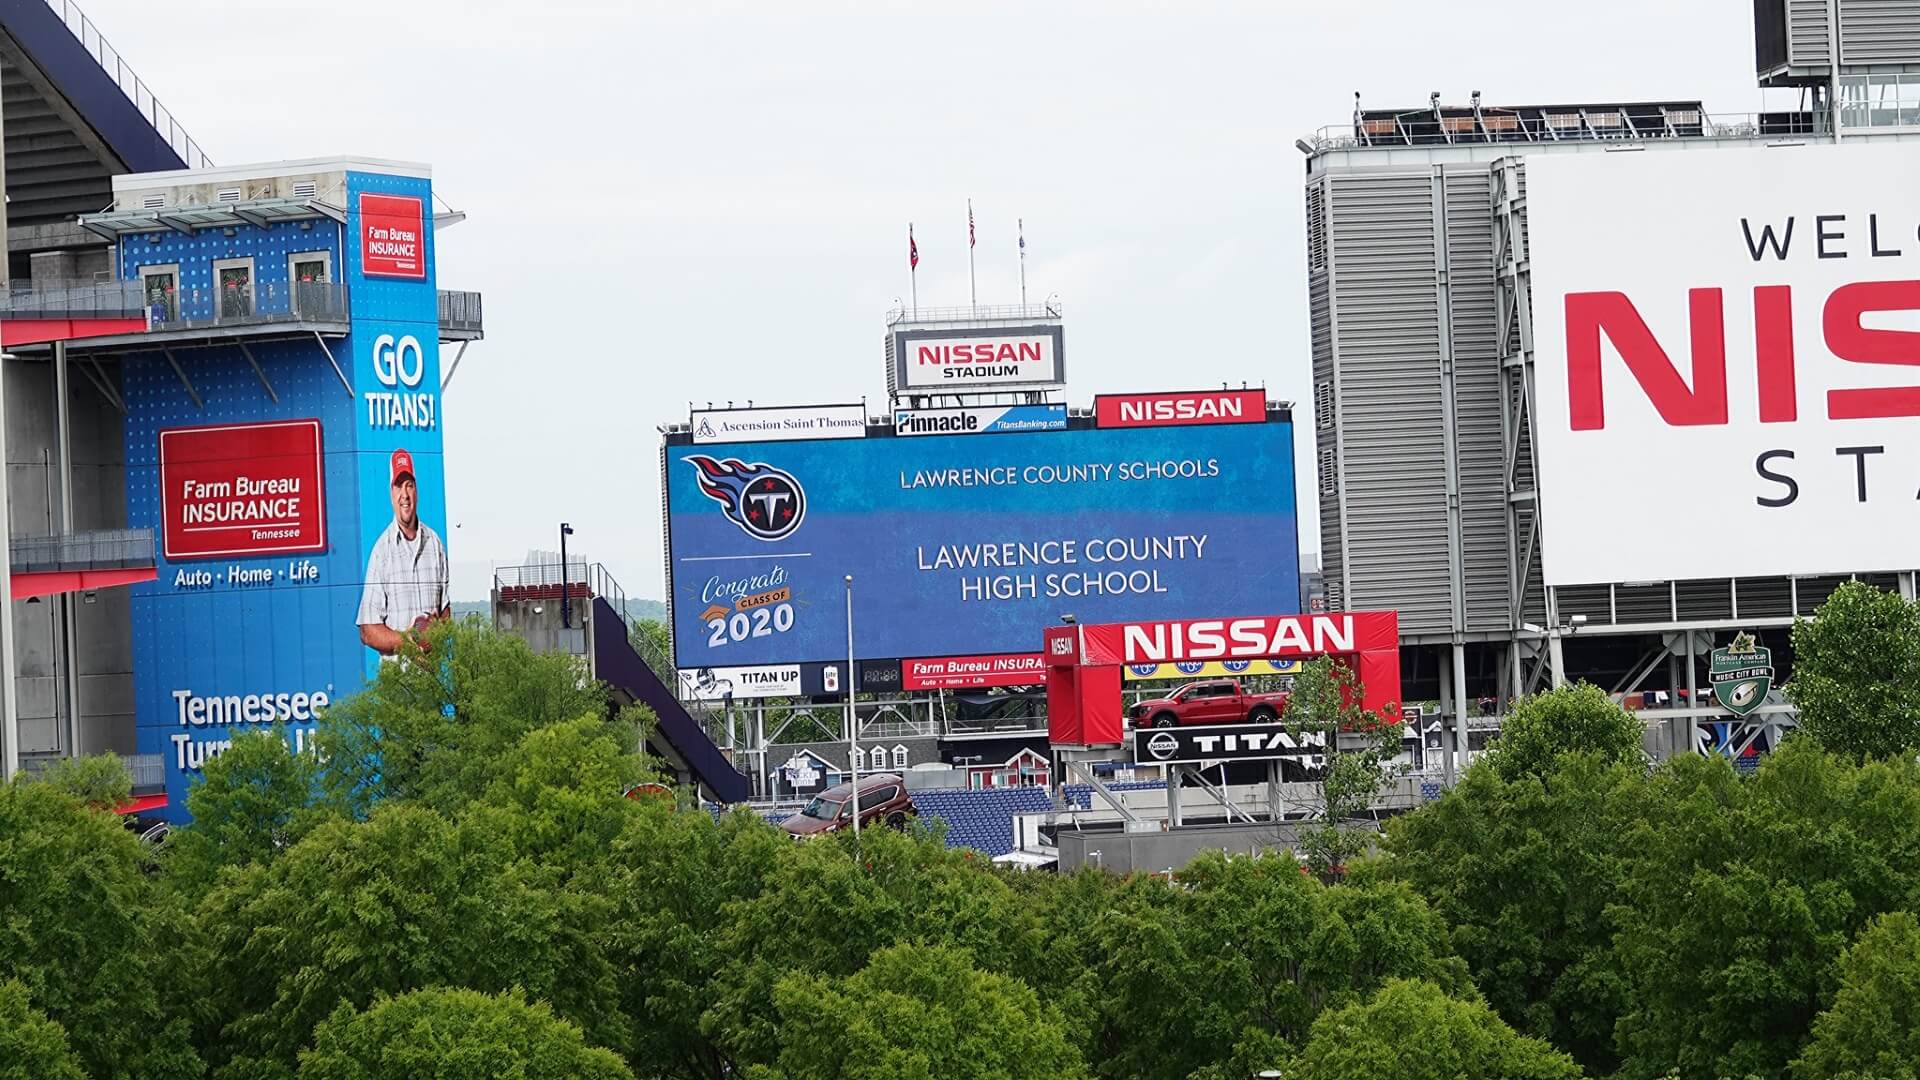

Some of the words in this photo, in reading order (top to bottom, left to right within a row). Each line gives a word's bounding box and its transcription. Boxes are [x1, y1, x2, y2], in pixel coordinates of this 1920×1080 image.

[369, 226, 388, 240] Farm
[390, 228, 415, 242] Bureau
[1740, 213, 1920, 261] WEL
[369, 241, 415, 257] INSURANCE
[373, 334, 423, 386] GO
[918, 342, 1041, 366] NISSAN
[943, 365, 1019, 378] STADIUM
[364, 392, 435, 427] TITANS!
[1120, 397, 1242, 421] NISSAN
[720, 420, 780, 432] Ascension
[783, 418, 814, 429] Saint
[816, 416, 864, 428] Thomas
[897, 411, 977, 433] Pinnacle
[996, 418, 1065, 430] TitansBanking.com
[900, 466, 1017, 489] LAWRENCE
[1023, 463, 1113, 484] COUNTY
[1119, 458, 1219, 481] SCHOOLS
[1755, 445, 1920, 508] ST
[183, 479, 230, 499] Farm
[236, 476, 300, 497] Bureau
[183, 498, 300, 524] INSURANCE
[251, 529, 300, 541] Tennessee
[918, 540, 1077, 570] LAWRENCE
[1085, 534, 1207, 563] COUNTY
[174, 568, 212, 586] Auto
[228, 565, 272, 583] Home
[289, 560, 318, 580] Life
[961, 574, 1037, 601] HIGH
[1045, 569, 1168, 598] SCHOOL
[740, 594, 770, 608] CLASS
[772, 591, 785, 602] OF
[707, 603, 794, 648] 2020
[1051, 637, 1073, 656] NISSAN
[1124, 615, 1355, 661] NISSAN
[913, 663, 943, 674] Farm
[948, 661, 990, 673] Bureau
[994, 658, 1046, 670] INSURA
[1715, 654, 1738, 662] Franklin
[740, 671, 777, 684] TITAN
[781, 670, 799, 682] UP
[1715, 672, 1735, 681] MUSIC
[1736, 670, 1750, 679] CITY
[1751, 668, 1768, 677] BOWL
[172, 690, 329, 725] Tennessee
[1193, 731, 1326, 752] TITAN
